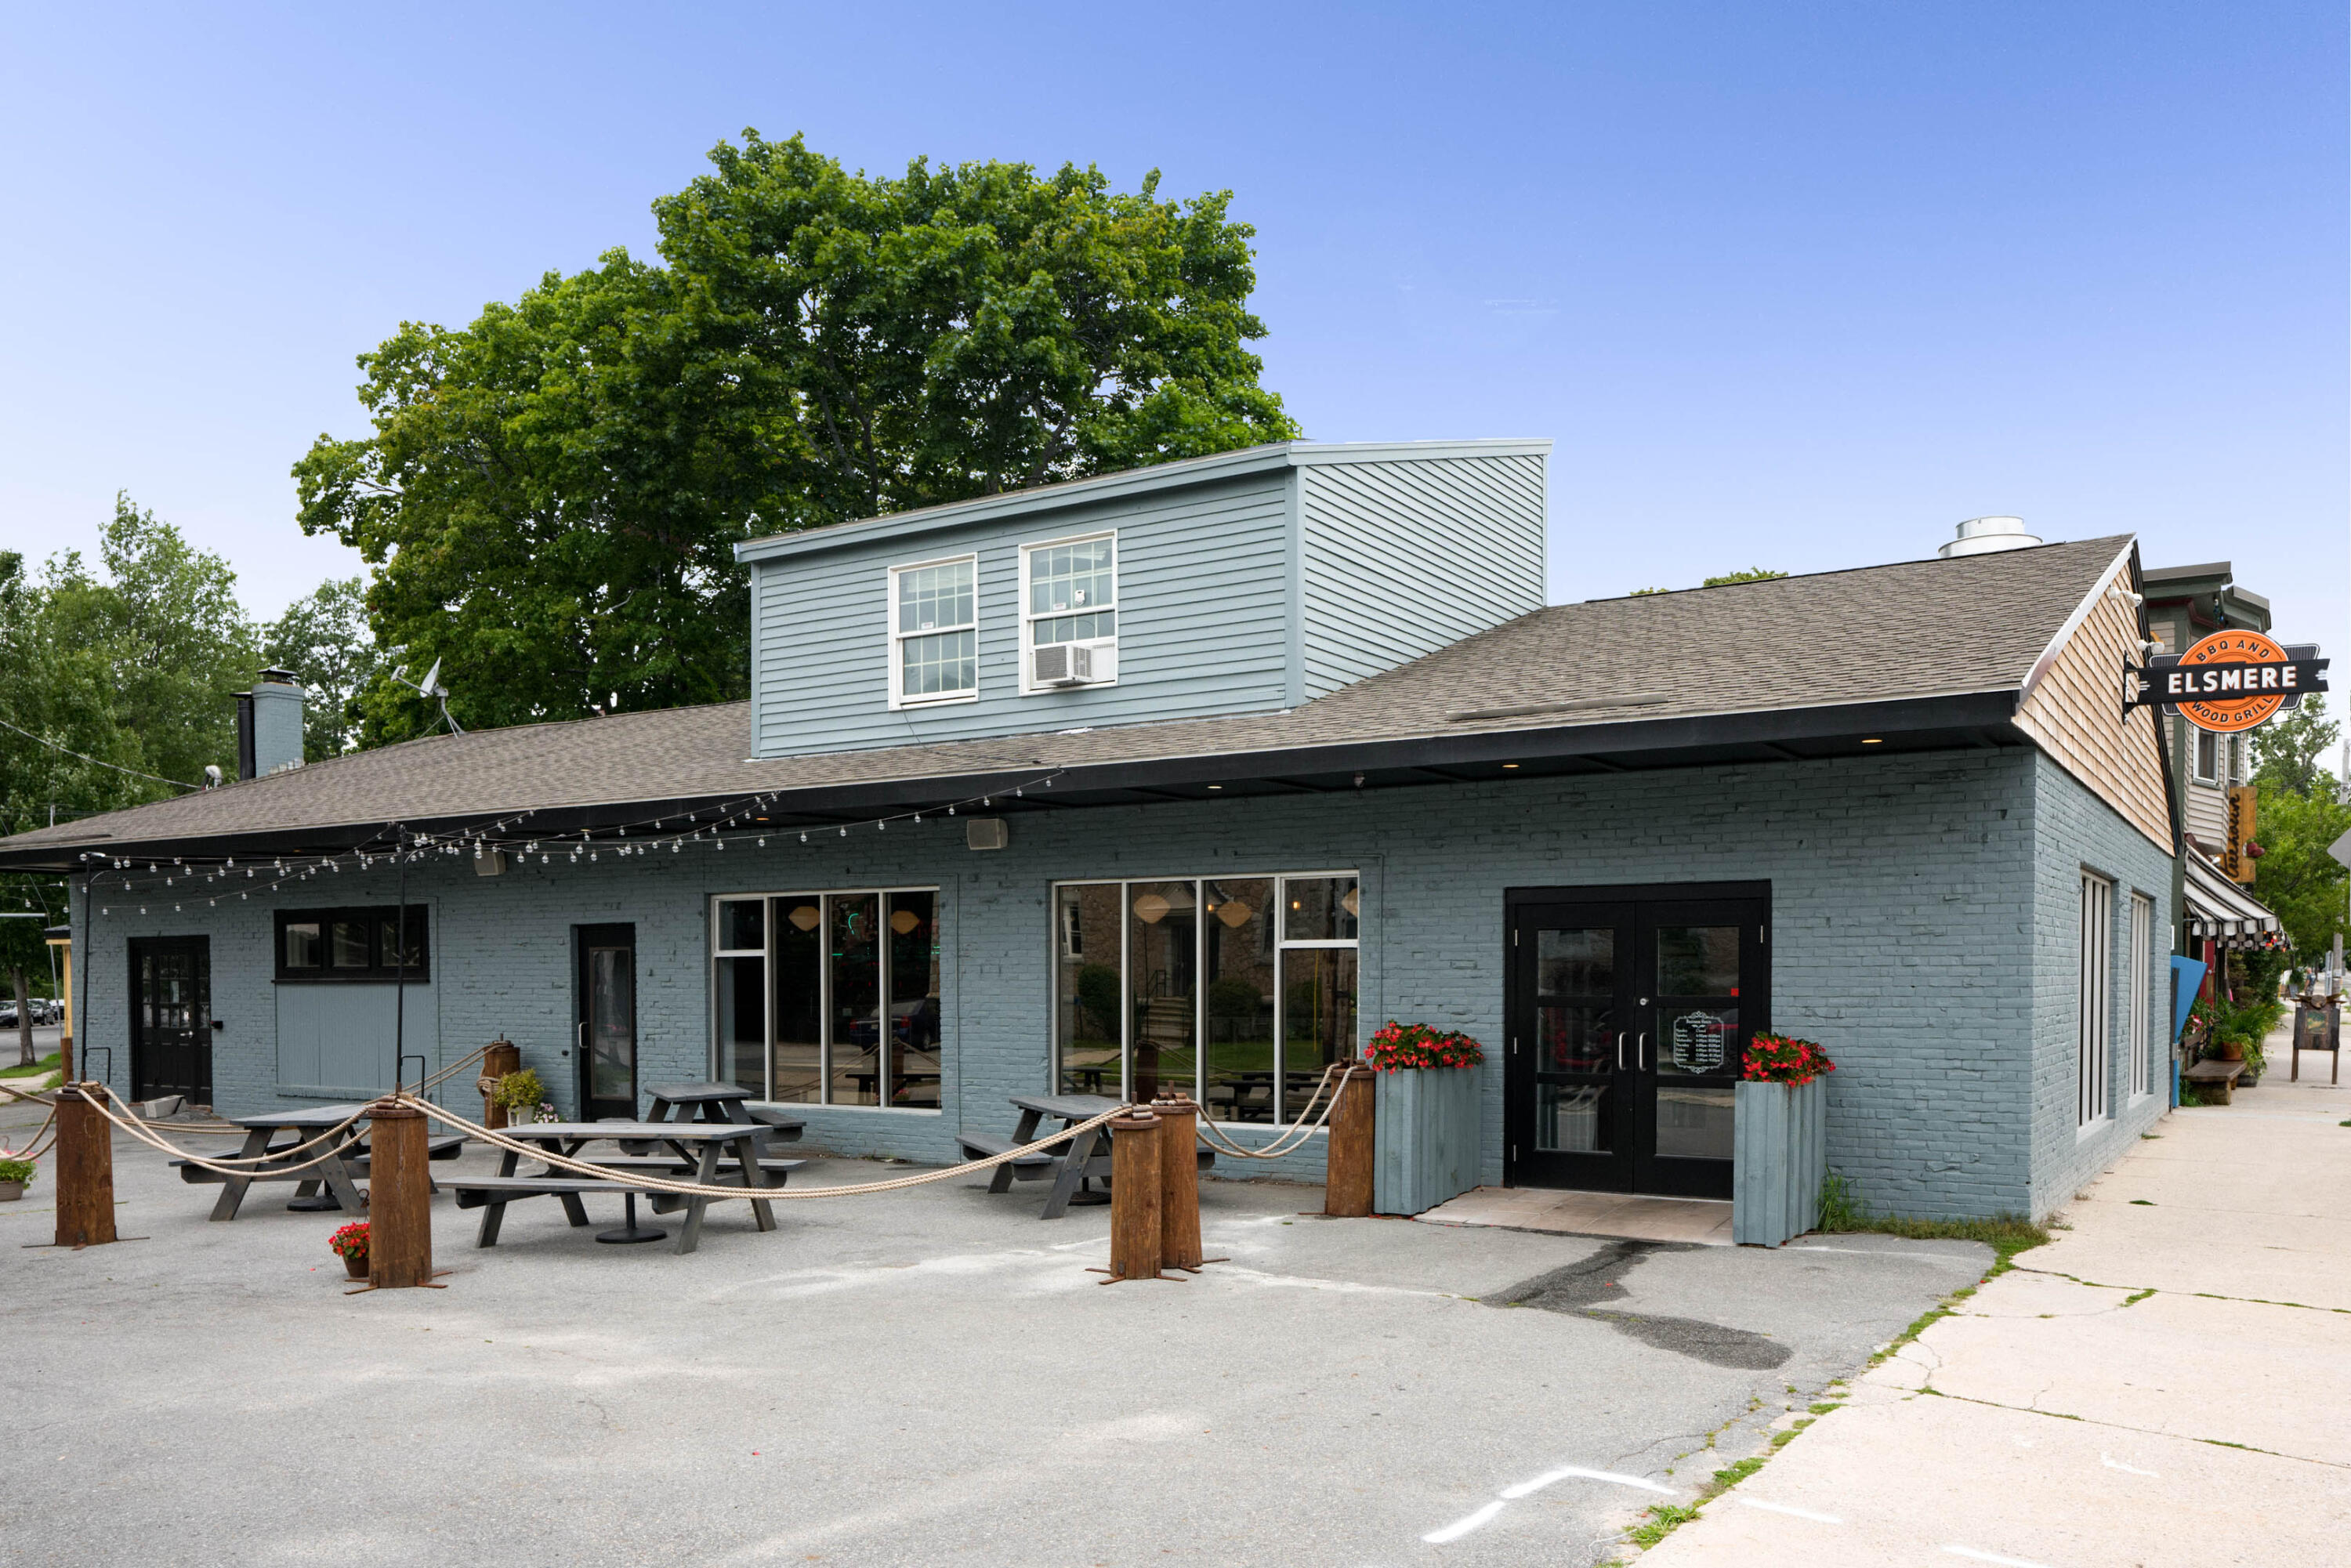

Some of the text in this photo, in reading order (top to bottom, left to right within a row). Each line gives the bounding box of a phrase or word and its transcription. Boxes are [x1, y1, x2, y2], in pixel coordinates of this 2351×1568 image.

[2197, 639, 2269, 661] BBQ AND
[2168, 666, 2297, 693] ELSMERE
[2192, 697, 2274, 722] WOOD GRILL
